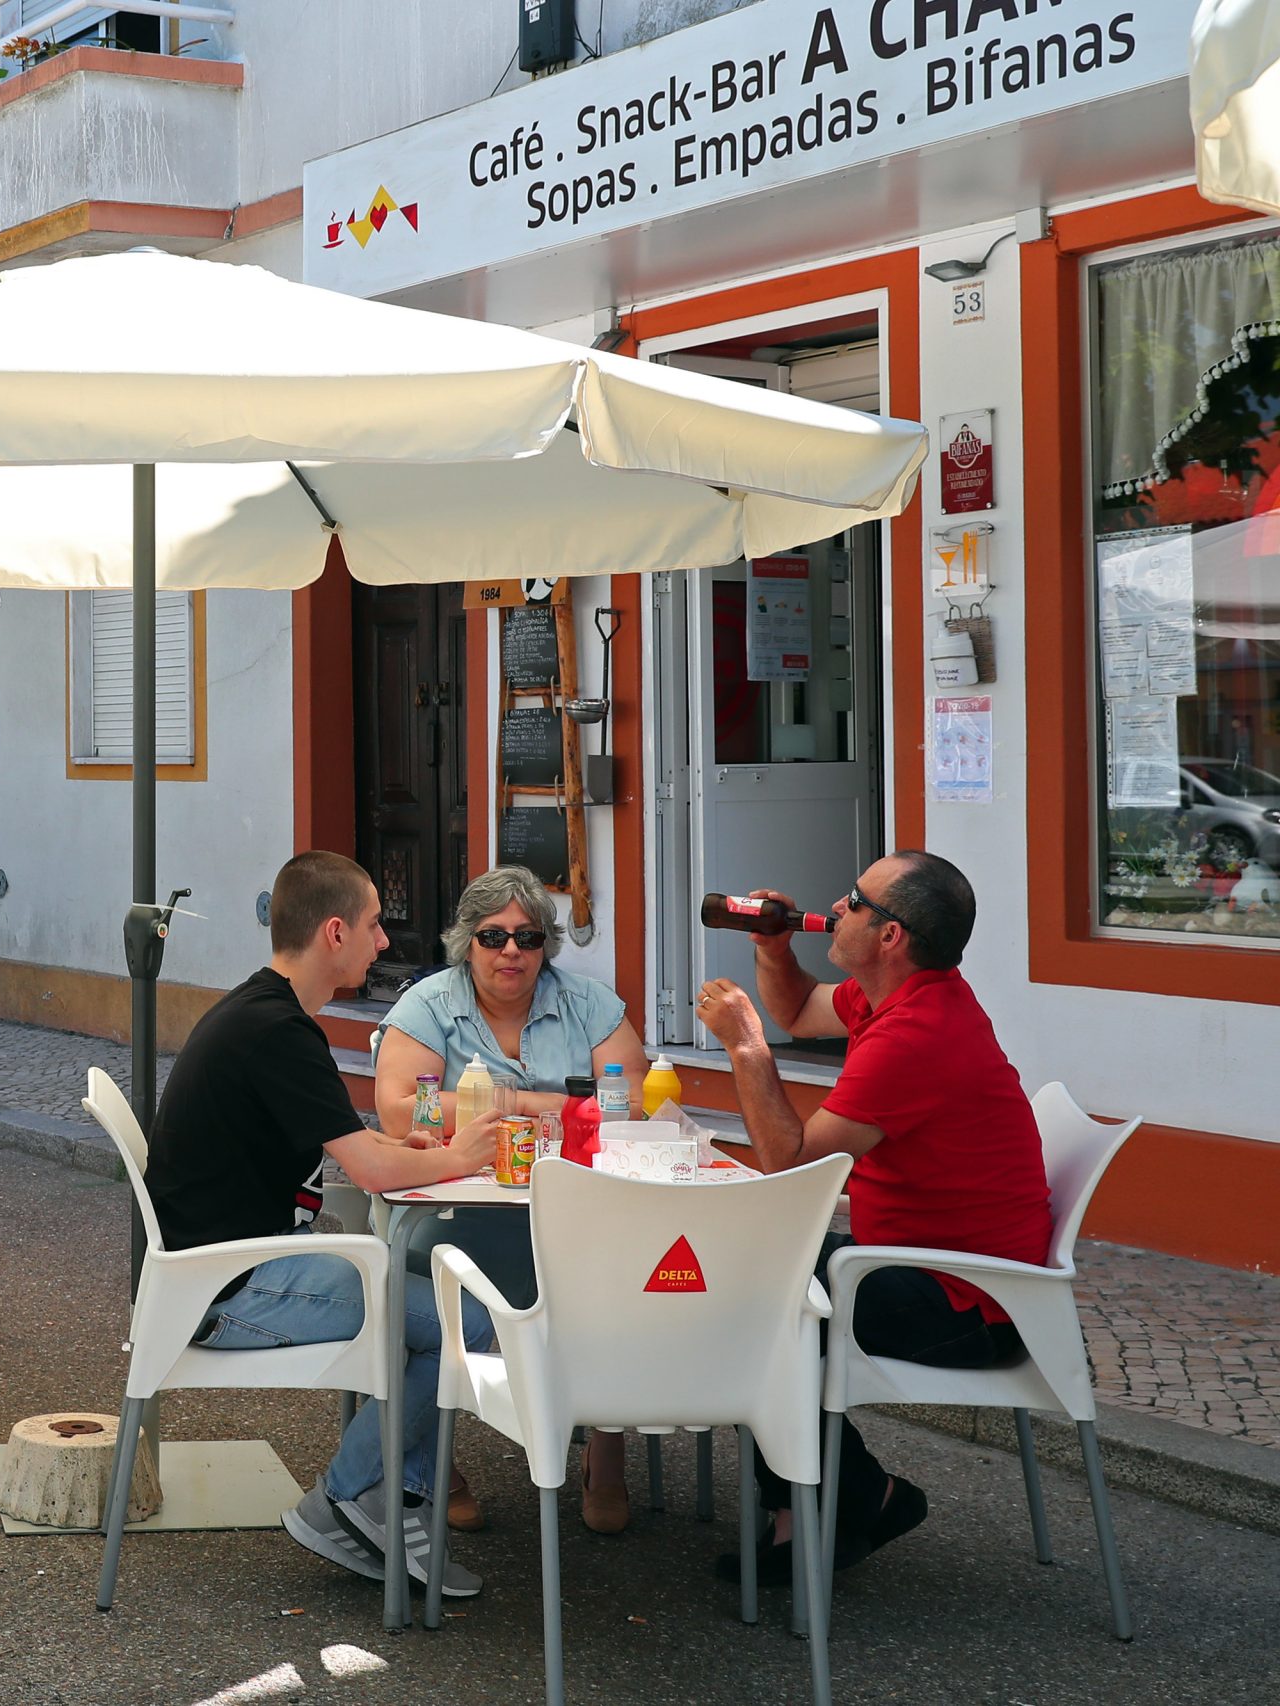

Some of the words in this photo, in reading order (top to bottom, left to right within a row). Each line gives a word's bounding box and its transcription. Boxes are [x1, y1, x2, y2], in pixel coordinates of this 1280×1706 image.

[469, 120, 544, 187] Café
[577, 50, 787, 155] Snack-Bar
[800, 8, 849, 86] A
[527, 162, 636, 229] Sopas
[674, 90, 878, 188] Empadas
[927, 12, 1136, 116] Bifanas
[953, 291, 982, 315] 53
[480, 586, 501, 601] 1984
[658, 1270, 698, 1281] DELTA
